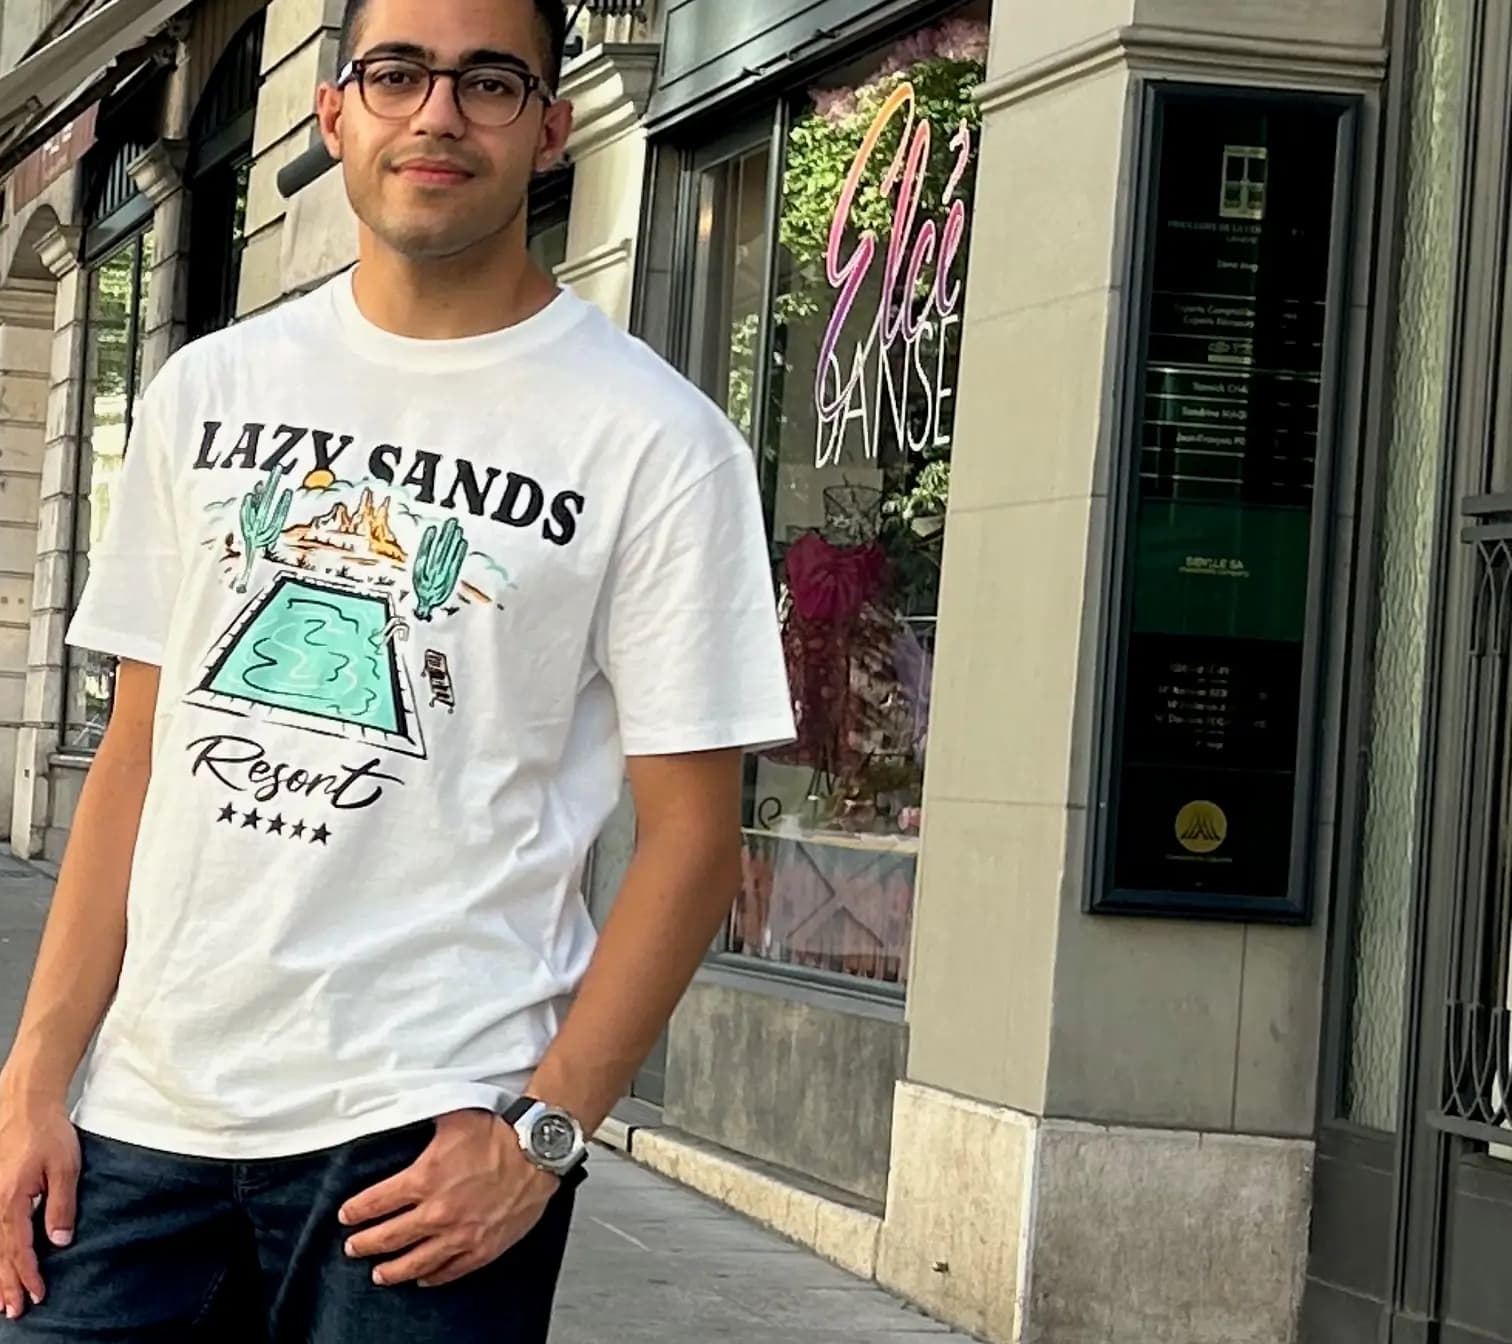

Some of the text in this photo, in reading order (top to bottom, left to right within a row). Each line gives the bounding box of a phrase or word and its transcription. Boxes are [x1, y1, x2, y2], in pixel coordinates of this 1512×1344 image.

[815, 315, 958, 469] DANSE
[192, 420, 586, 547] LAZY SANDS
[185, 734, 406, 810] Resort
